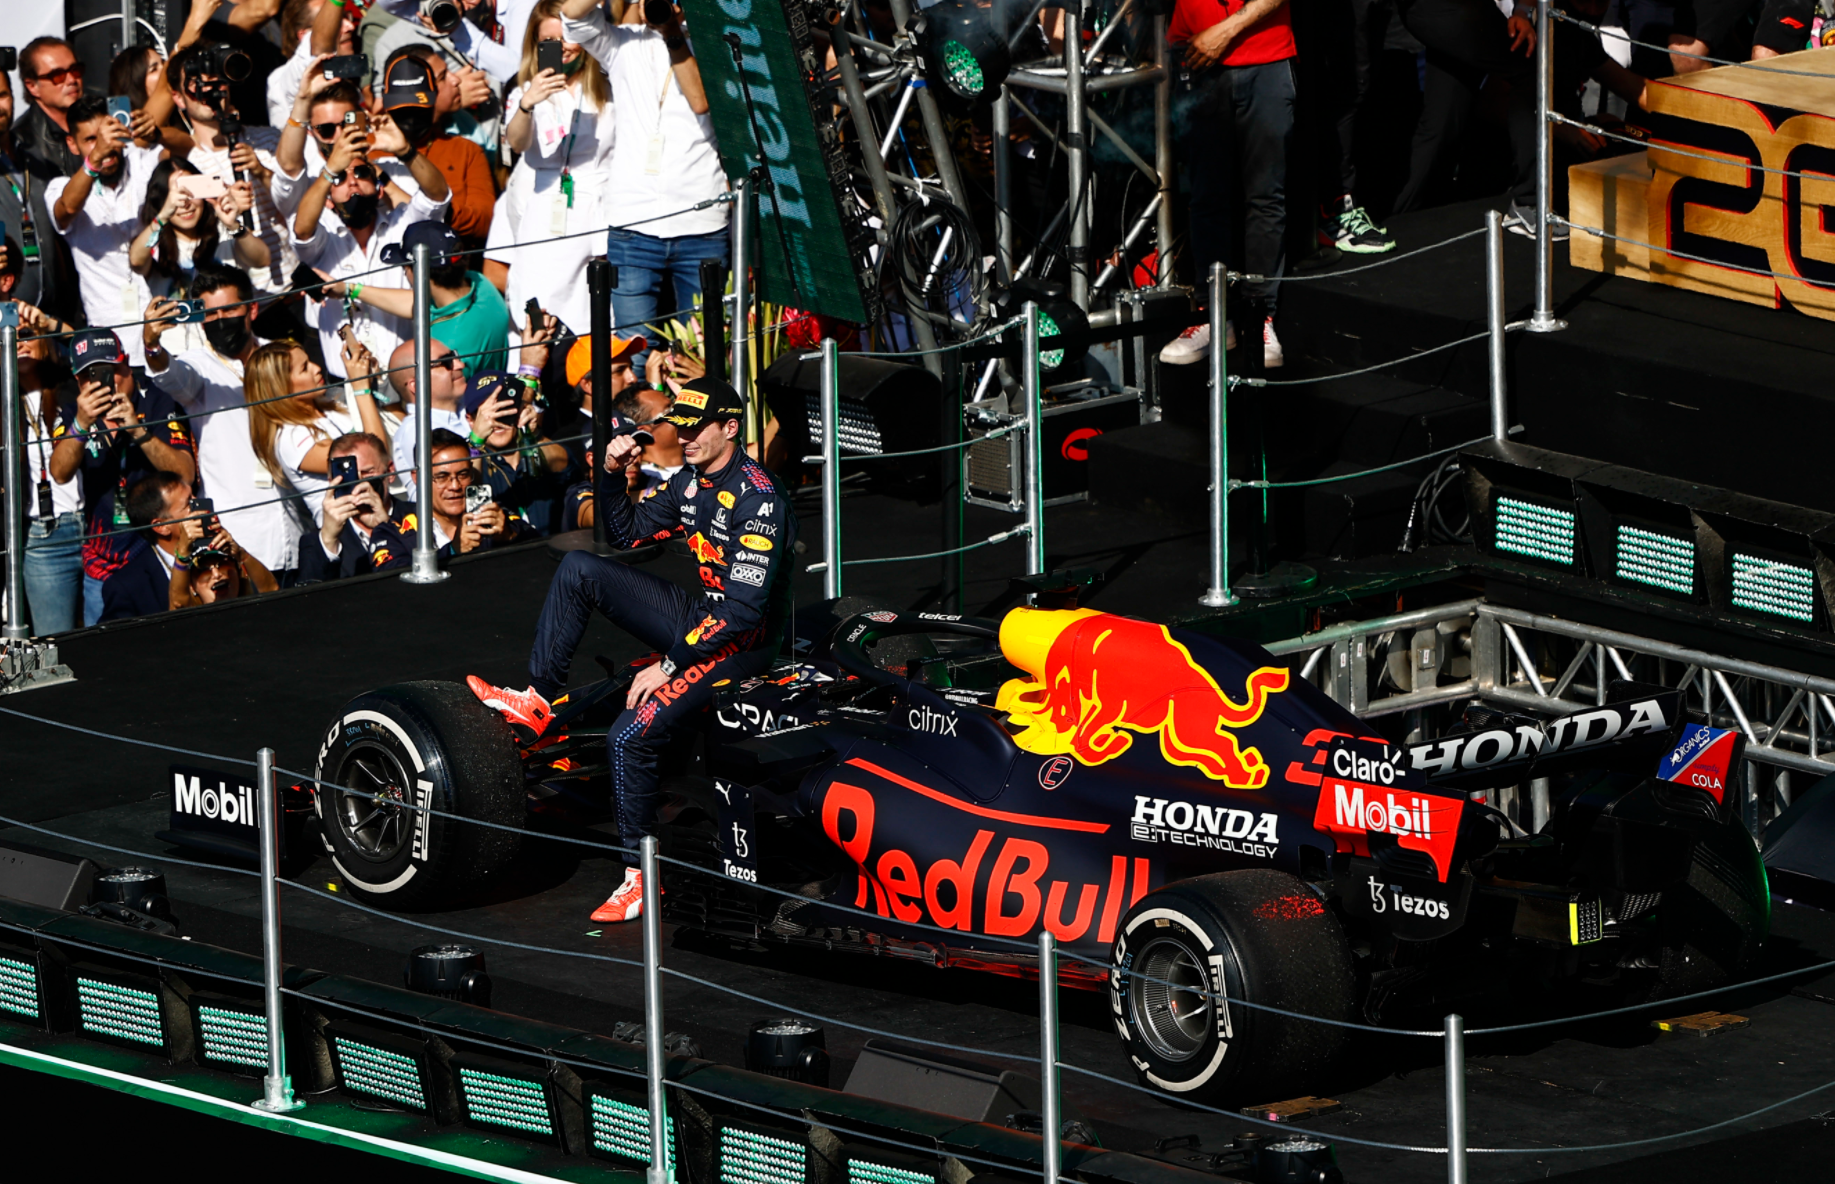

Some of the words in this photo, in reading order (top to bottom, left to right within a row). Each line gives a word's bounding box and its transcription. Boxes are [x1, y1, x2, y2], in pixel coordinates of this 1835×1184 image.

[415, 91, 429, 104] 3
[757, 502, 774, 517] A1
[744, 519, 778, 536] citrix
[748, 537, 769, 548] RAUCH
[747, 552, 770, 564] INTER
[733, 566, 762, 582] OXXO
[918, 612, 962, 621] telcel
[908, 705, 959, 738] citrix
[1409, 699, 1671, 777] HONDA
[1333, 747, 1396, 785] Claro
[1691, 773, 1723, 790] COLA
[174, 773, 254, 826] Mobil
[1334, 784, 1432, 840] Mobil
[413, 779, 434, 862] PIRELLI
[1131, 795, 1280, 844] HONDA
[724, 858, 757, 883] Tezos
[1390, 884, 1450, 920] Tezos
[1208, 954, 1234, 1039] PIRELLI
